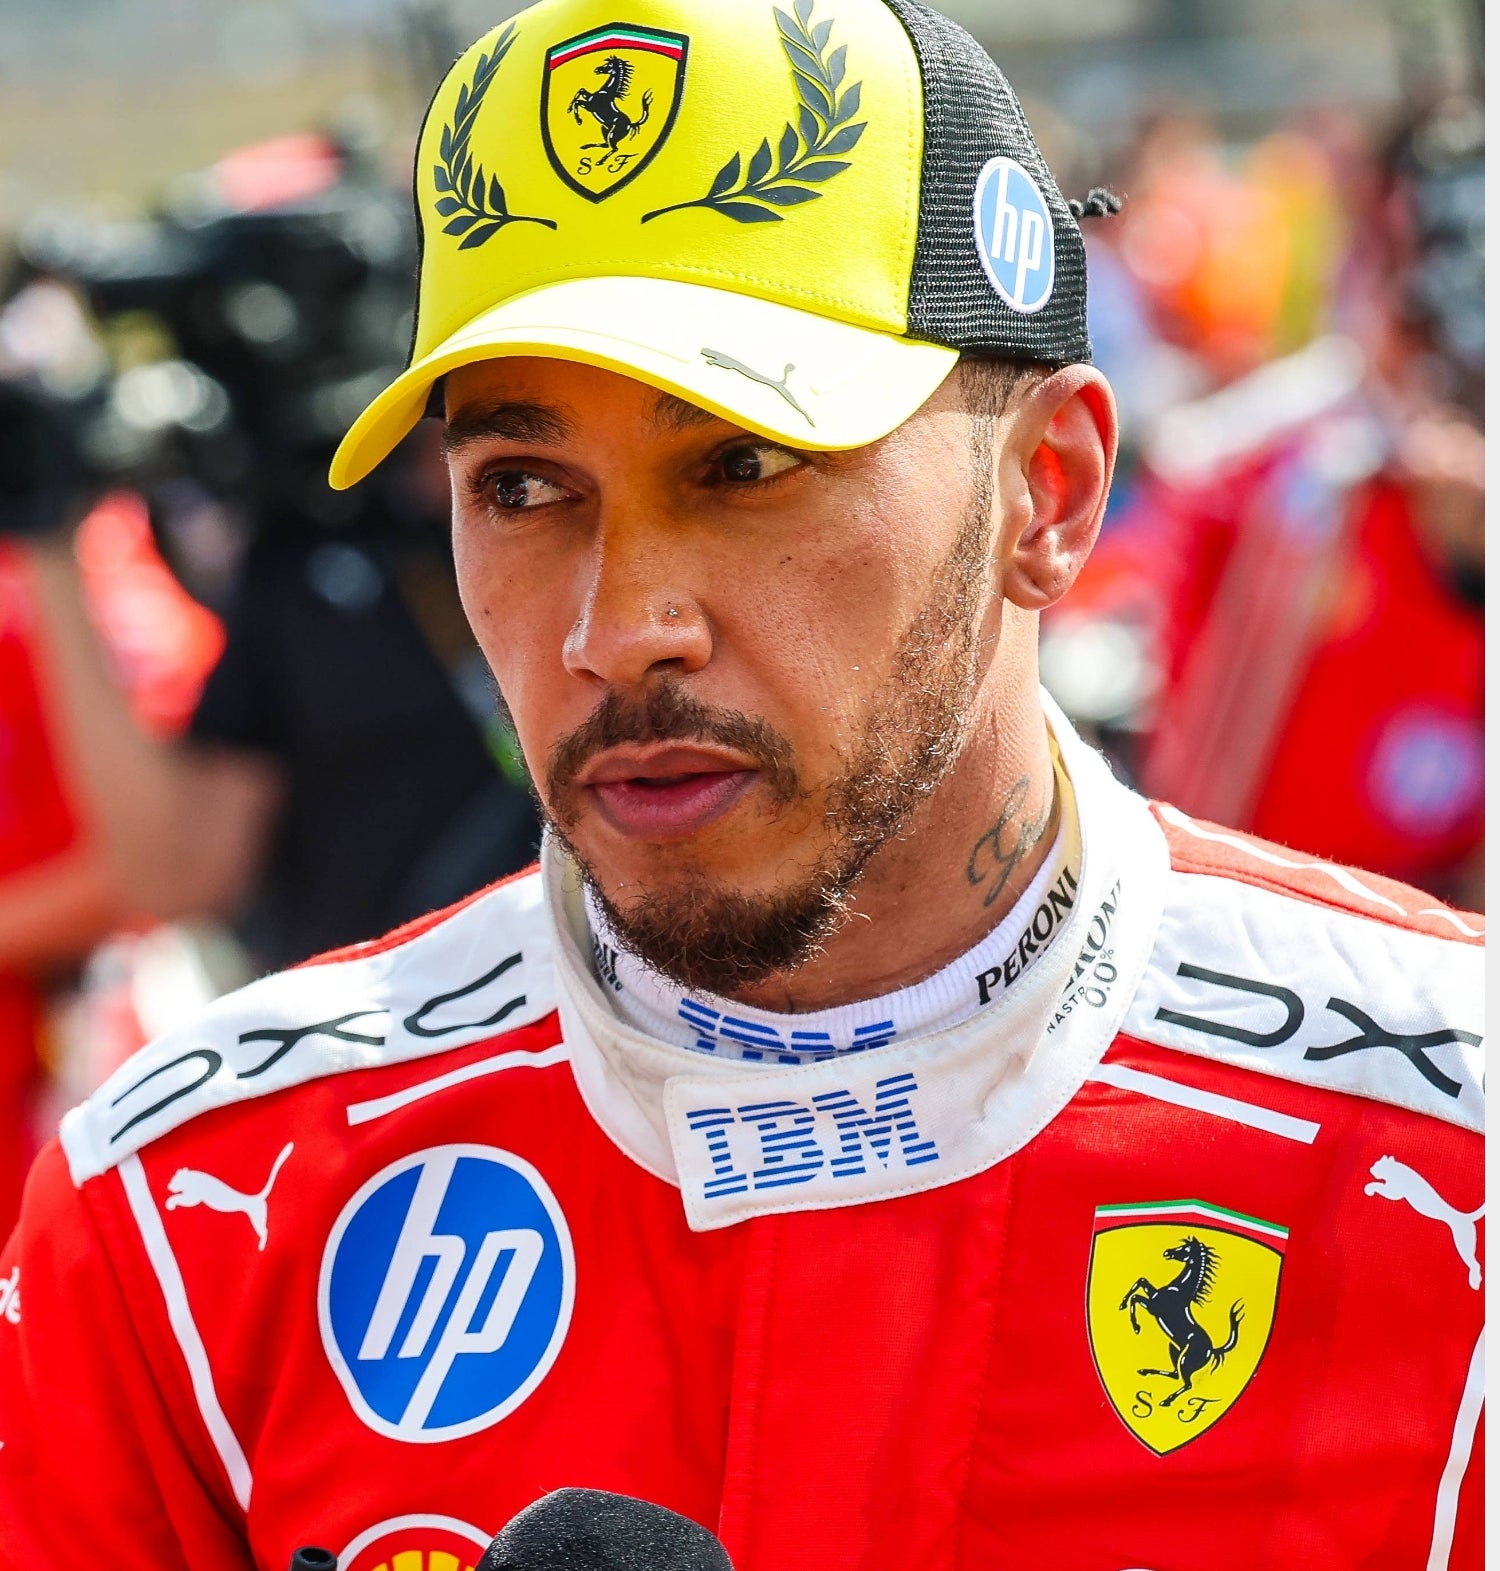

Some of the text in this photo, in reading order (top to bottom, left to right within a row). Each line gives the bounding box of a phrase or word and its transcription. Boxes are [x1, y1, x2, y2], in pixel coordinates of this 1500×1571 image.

[577, 153, 639, 175] S F
[991, 167, 1045, 304] hp
[975, 866, 1079, 1006] PERONI
[686, 1072, 938, 1199] IBM
[357, 1157, 544, 1430] hp
[1132, 1390, 1222, 1423] S F
